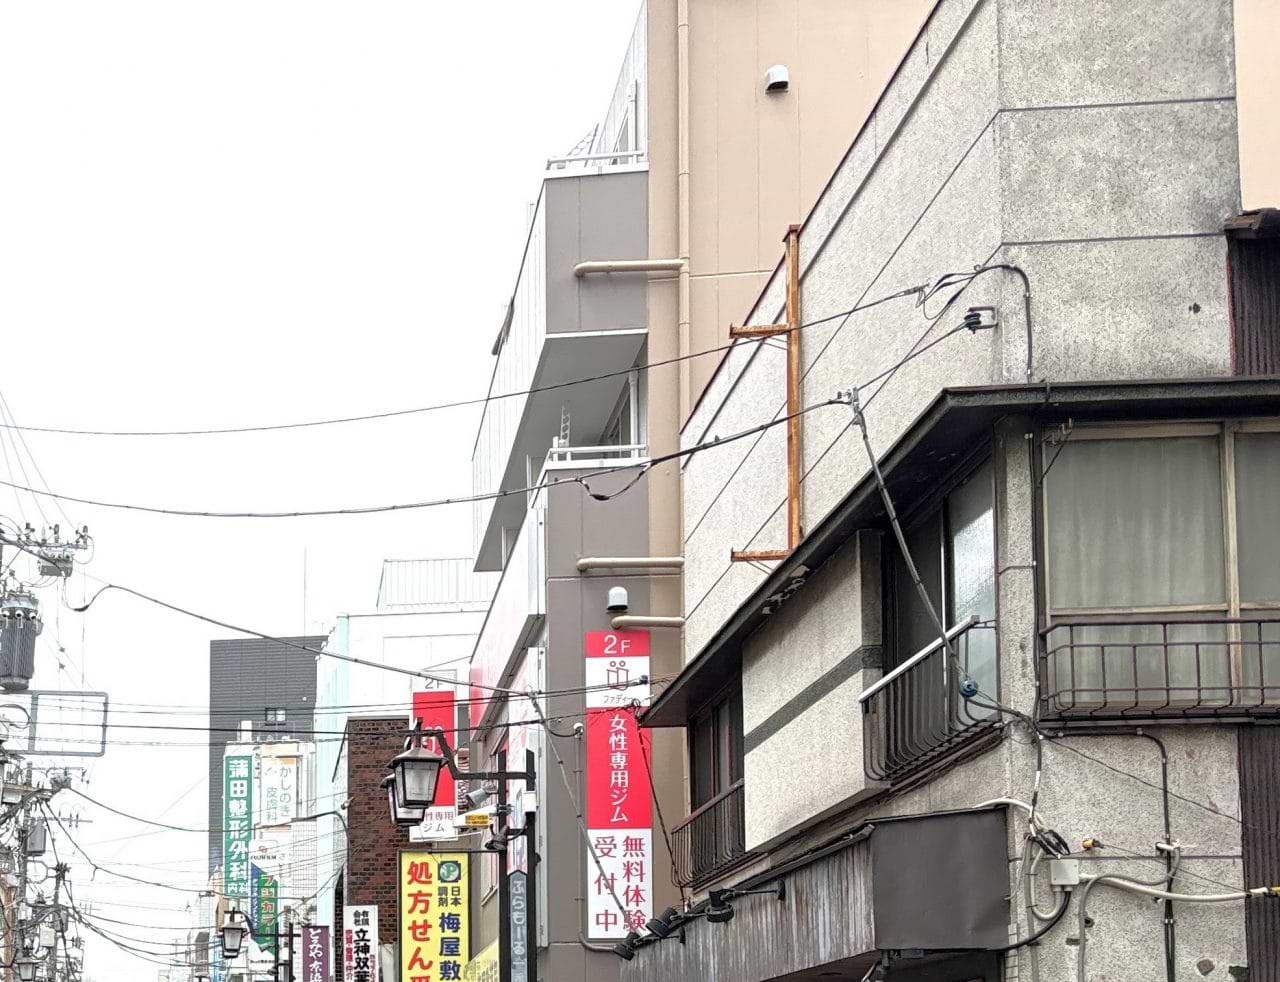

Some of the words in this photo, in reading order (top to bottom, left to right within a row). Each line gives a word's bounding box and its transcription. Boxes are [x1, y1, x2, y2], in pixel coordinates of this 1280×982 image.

[604, 634, 631, 654] 2F
[424, 811, 454, 822] 性専用
[609, 714, 629, 823] 女性専用ジム
[228, 760, 249, 880] 蒲田整形外科
[451, 886, 462, 907] 日本
[594, 836, 618, 933] 受付中
[622, 835, 647, 933] 無料体験
